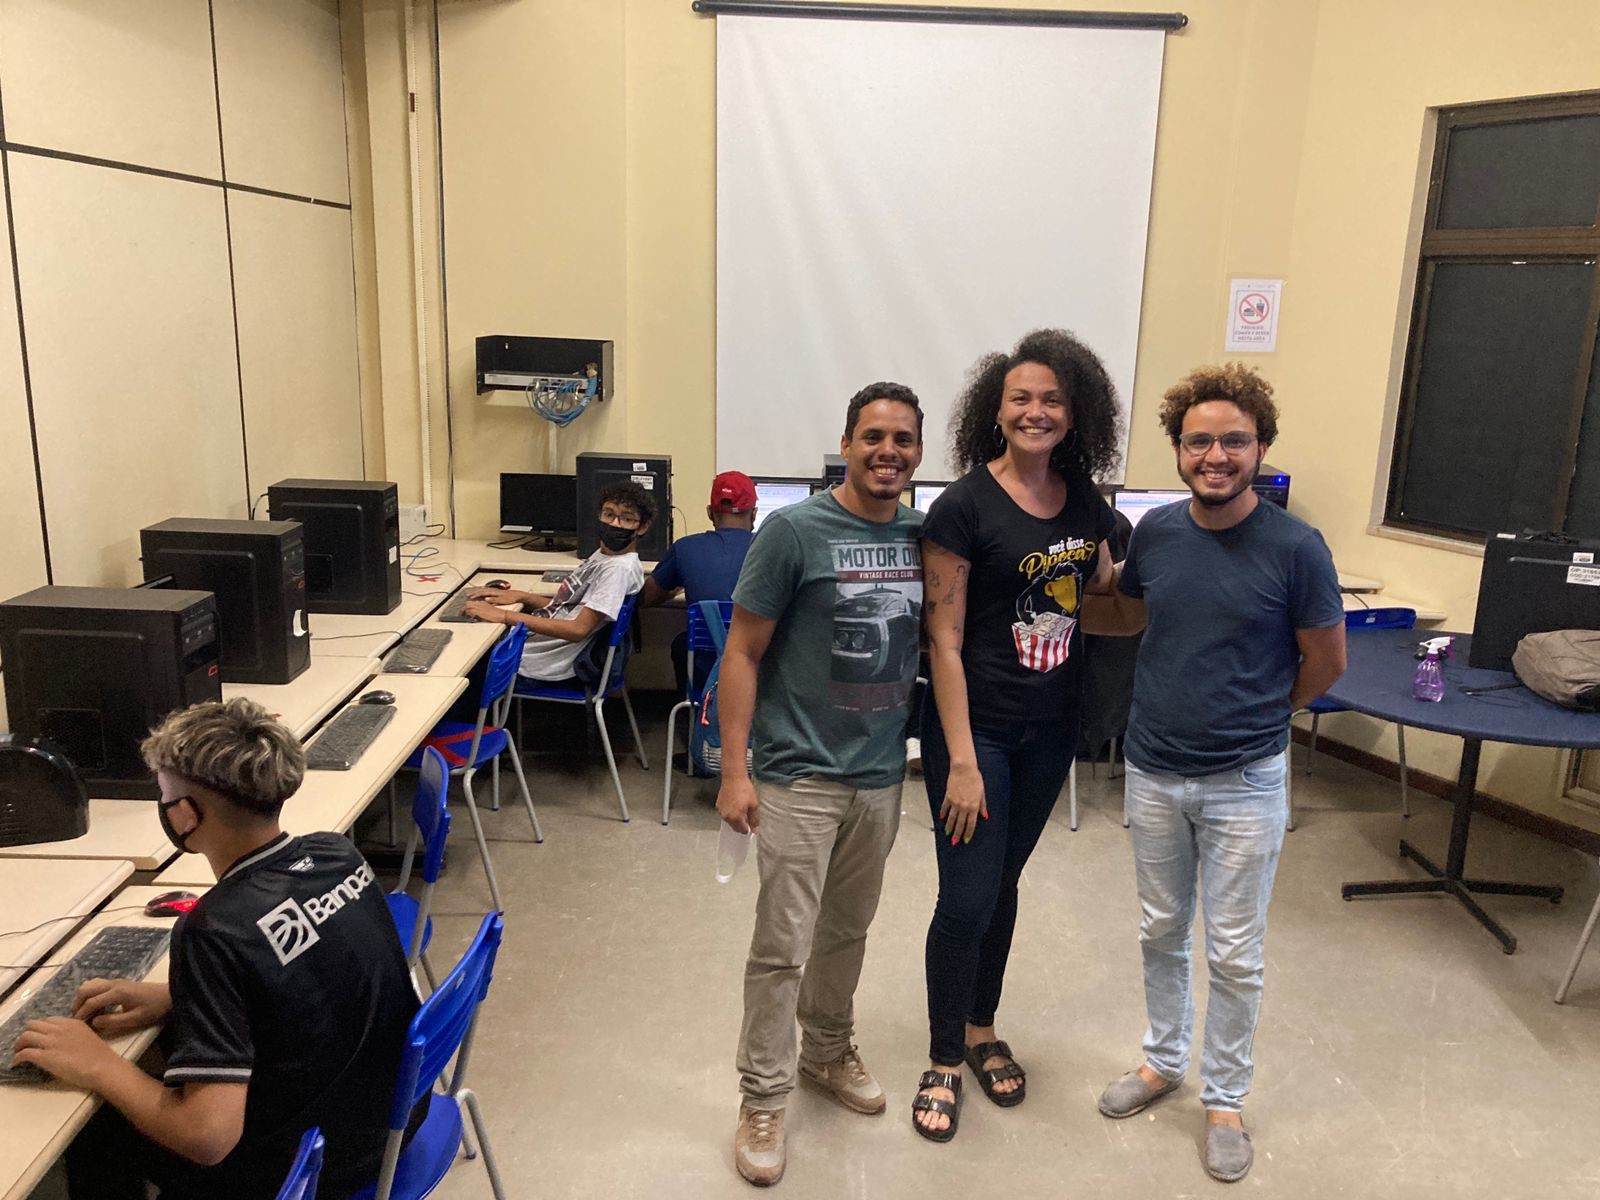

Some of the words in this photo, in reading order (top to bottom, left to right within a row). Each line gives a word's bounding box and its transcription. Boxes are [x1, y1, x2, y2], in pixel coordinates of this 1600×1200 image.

[837, 547, 898, 567] MOTOR
[859, 571, 883, 579] VINTAGE
[884, 571, 899, 579] RACE
[900, 570, 914, 578] CLUB
[302, 861, 376, 926] Banpa
